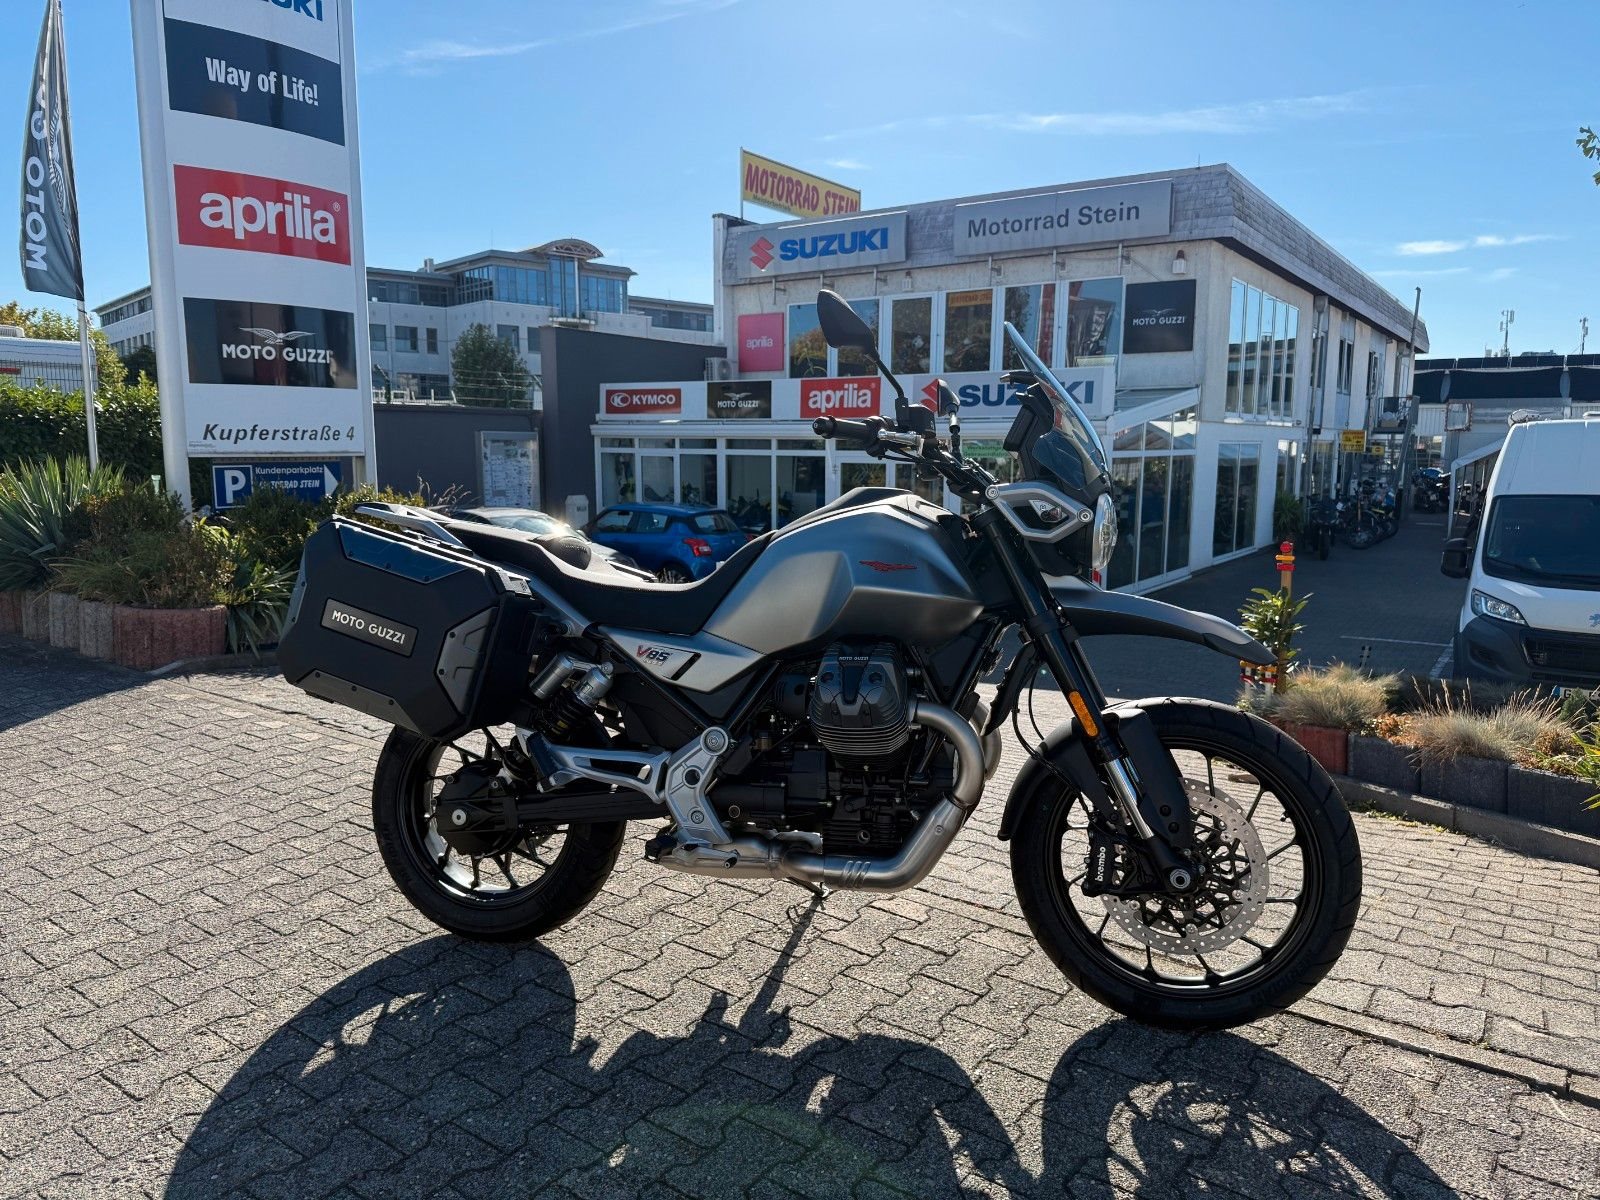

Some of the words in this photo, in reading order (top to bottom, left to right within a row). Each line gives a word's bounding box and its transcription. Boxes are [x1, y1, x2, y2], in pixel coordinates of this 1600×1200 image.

[205, 57, 251, 93] Way
[257, 71, 277, 95] of
[282, 74, 319, 106] Life!
[745, 163, 819, 212] MOTORRAD
[967, 209, 1070, 238] Motorrad
[1078, 202, 1140, 226] Stein
[779, 227, 889, 261] SUZUKI
[1132, 317, 1156, 326] MOTO
[1159, 316, 1185, 325] GUZZI
[222, 343, 276, 360] MOTO
[282, 347, 330, 364] GUZZI
[746, 336, 774, 350] aprilia
[632, 394, 676, 405] KYMCO
[717, 400, 736, 408] MOTO
[738, 400, 759, 408] GUZZI
[808, 383, 872, 413] aprilia
[202, 423, 341, 445] Kupferstraße
[346, 426, 355, 441] 4
[224, 469, 246, 504] P
[255, 465, 325, 475] Kundenparkplatz
[299, 480, 320, 488] STEIN
[332, 610, 365, 630] MOTO
[368, 623, 406, 645] GUZZI
[637, 645, 671, 662] V85
[1094, 846, 1106, 882] brembo
